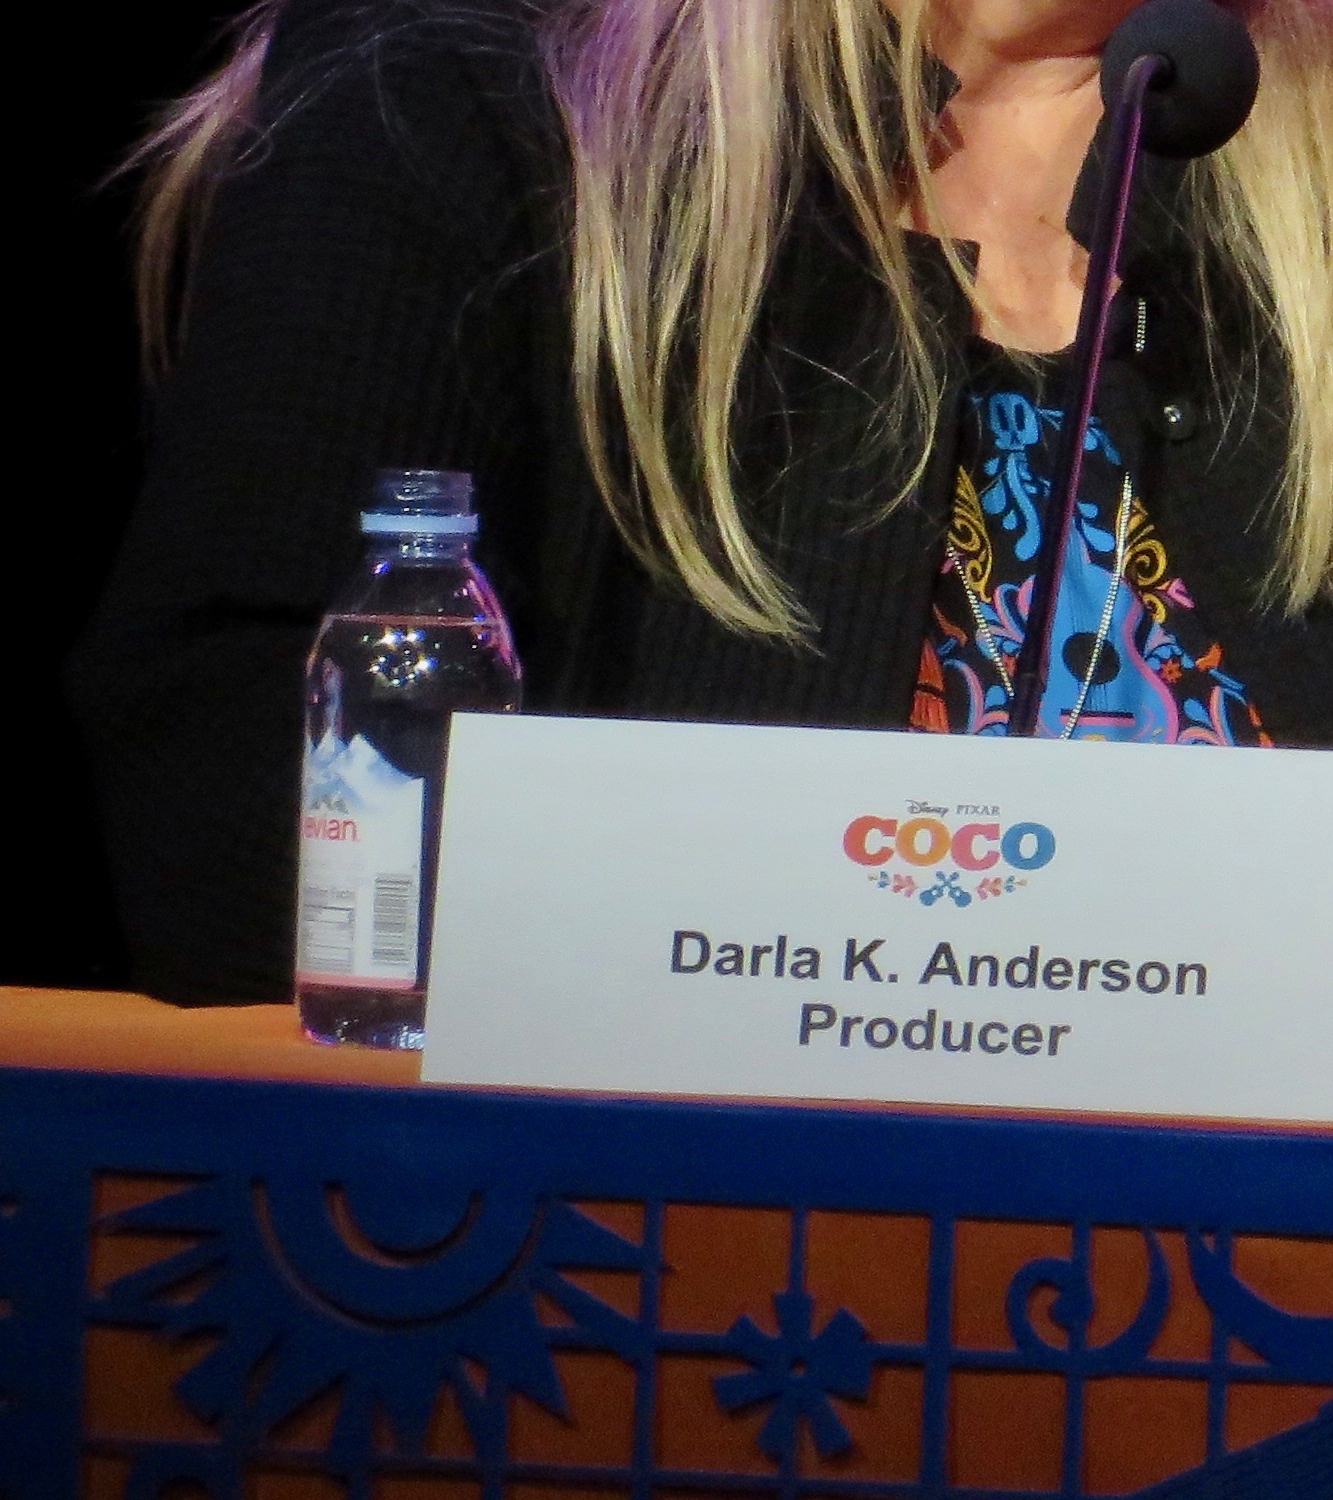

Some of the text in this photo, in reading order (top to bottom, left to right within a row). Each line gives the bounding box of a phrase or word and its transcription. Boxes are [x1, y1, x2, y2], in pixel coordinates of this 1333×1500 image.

[904, 798, 1000, 818] Disney PIXAR
[843, 815, 1056, 872] COCO
[669, 929, 1209, 997] Darla K. Anderson
[797, 1002, 1072, 1057] Producer
